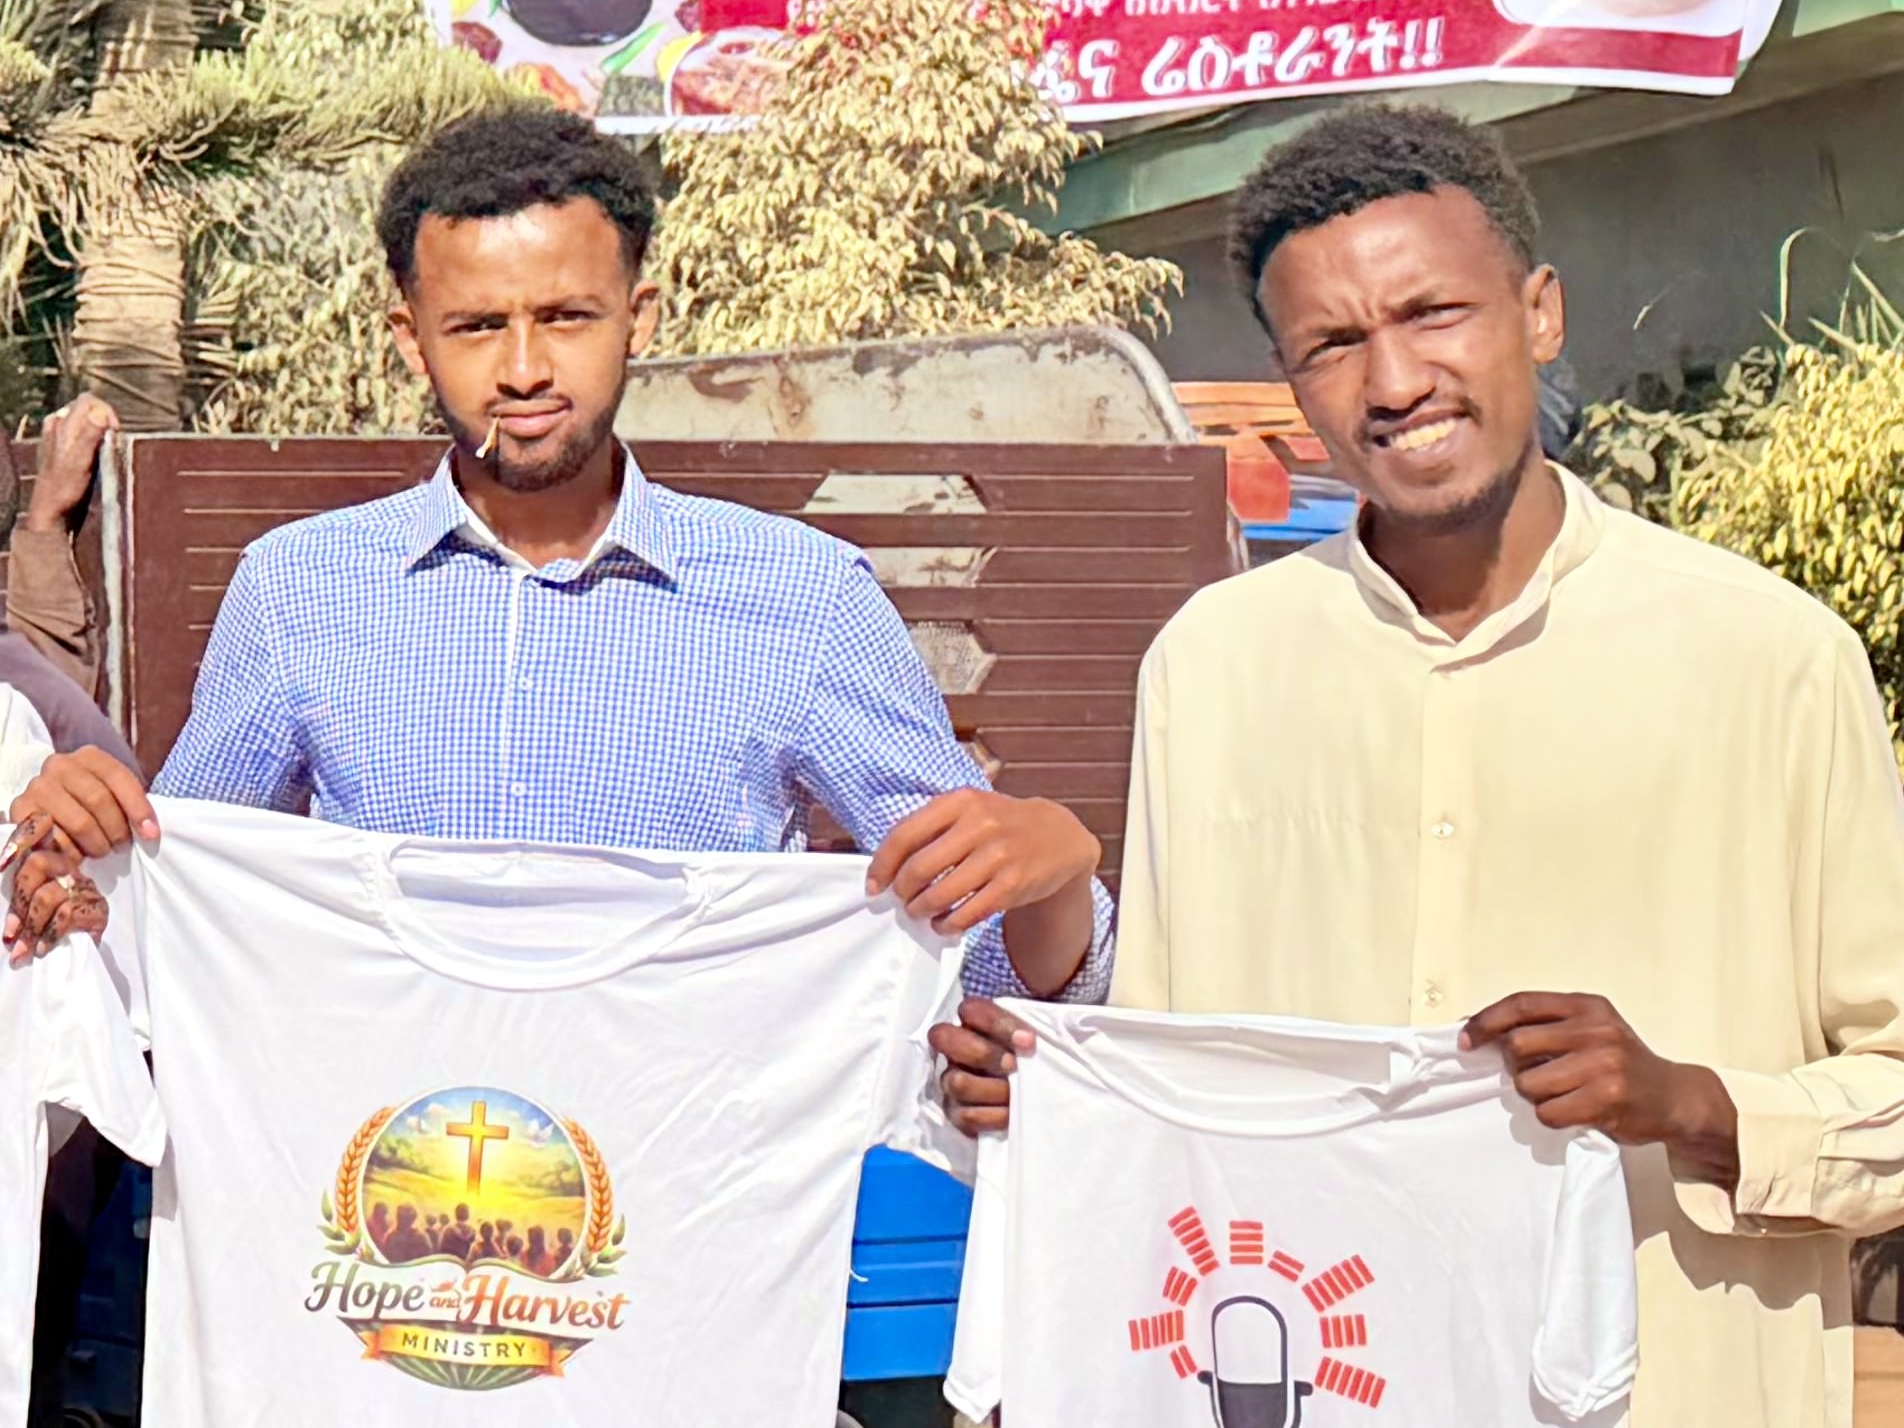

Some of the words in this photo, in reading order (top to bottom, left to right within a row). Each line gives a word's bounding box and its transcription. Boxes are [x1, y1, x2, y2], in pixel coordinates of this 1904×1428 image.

[304, 1260, 425, 1320] Hope
[428, 1291, 462, 1310] and
[456, 1273, 632, 1330] Harvest
[401, 1331, 527, 1359] MINISTRY
